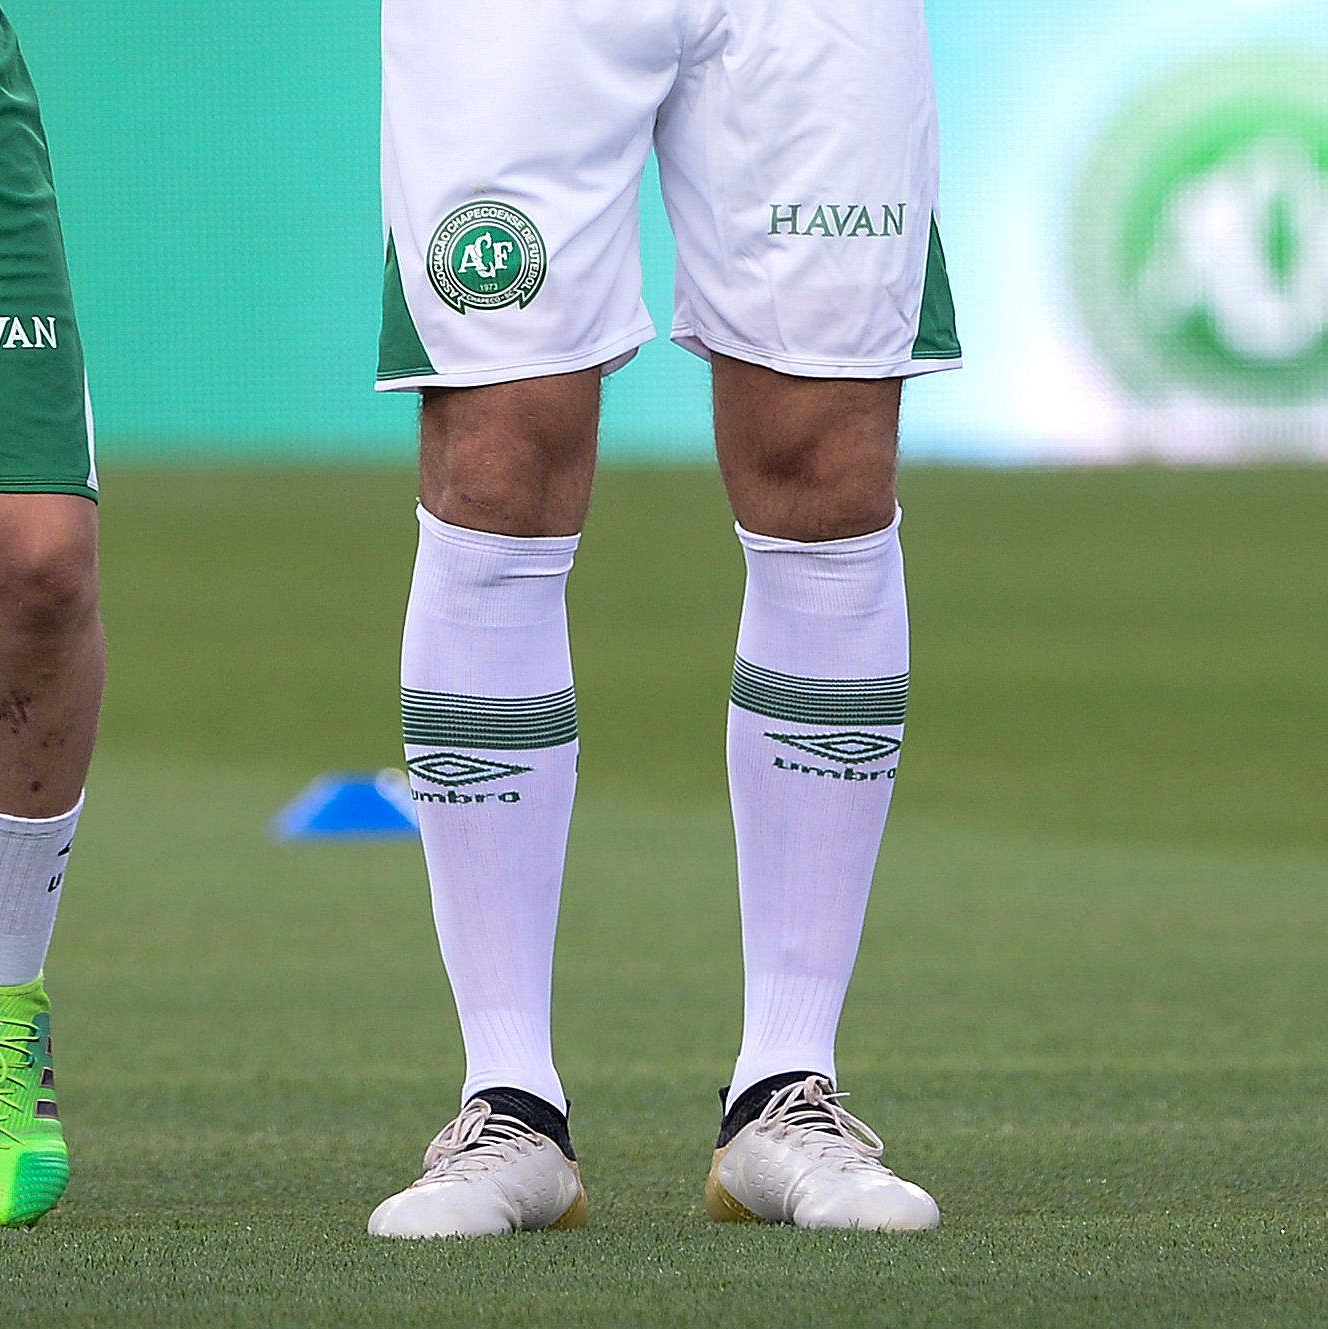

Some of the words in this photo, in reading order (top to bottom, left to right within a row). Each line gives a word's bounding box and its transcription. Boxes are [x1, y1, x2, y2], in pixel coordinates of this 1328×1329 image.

[447, 208, 525, 232] CHAPECOENSE
[767, 202, 906, 238] HAVAN
[521, 228, 535, 244] DE
[521, 243, 539, 290] FUTEBOL
[480, 283, 498, 291] 1973
[773, 757, 896, 781] umbro
[411, 789, 521, 804] umbro
